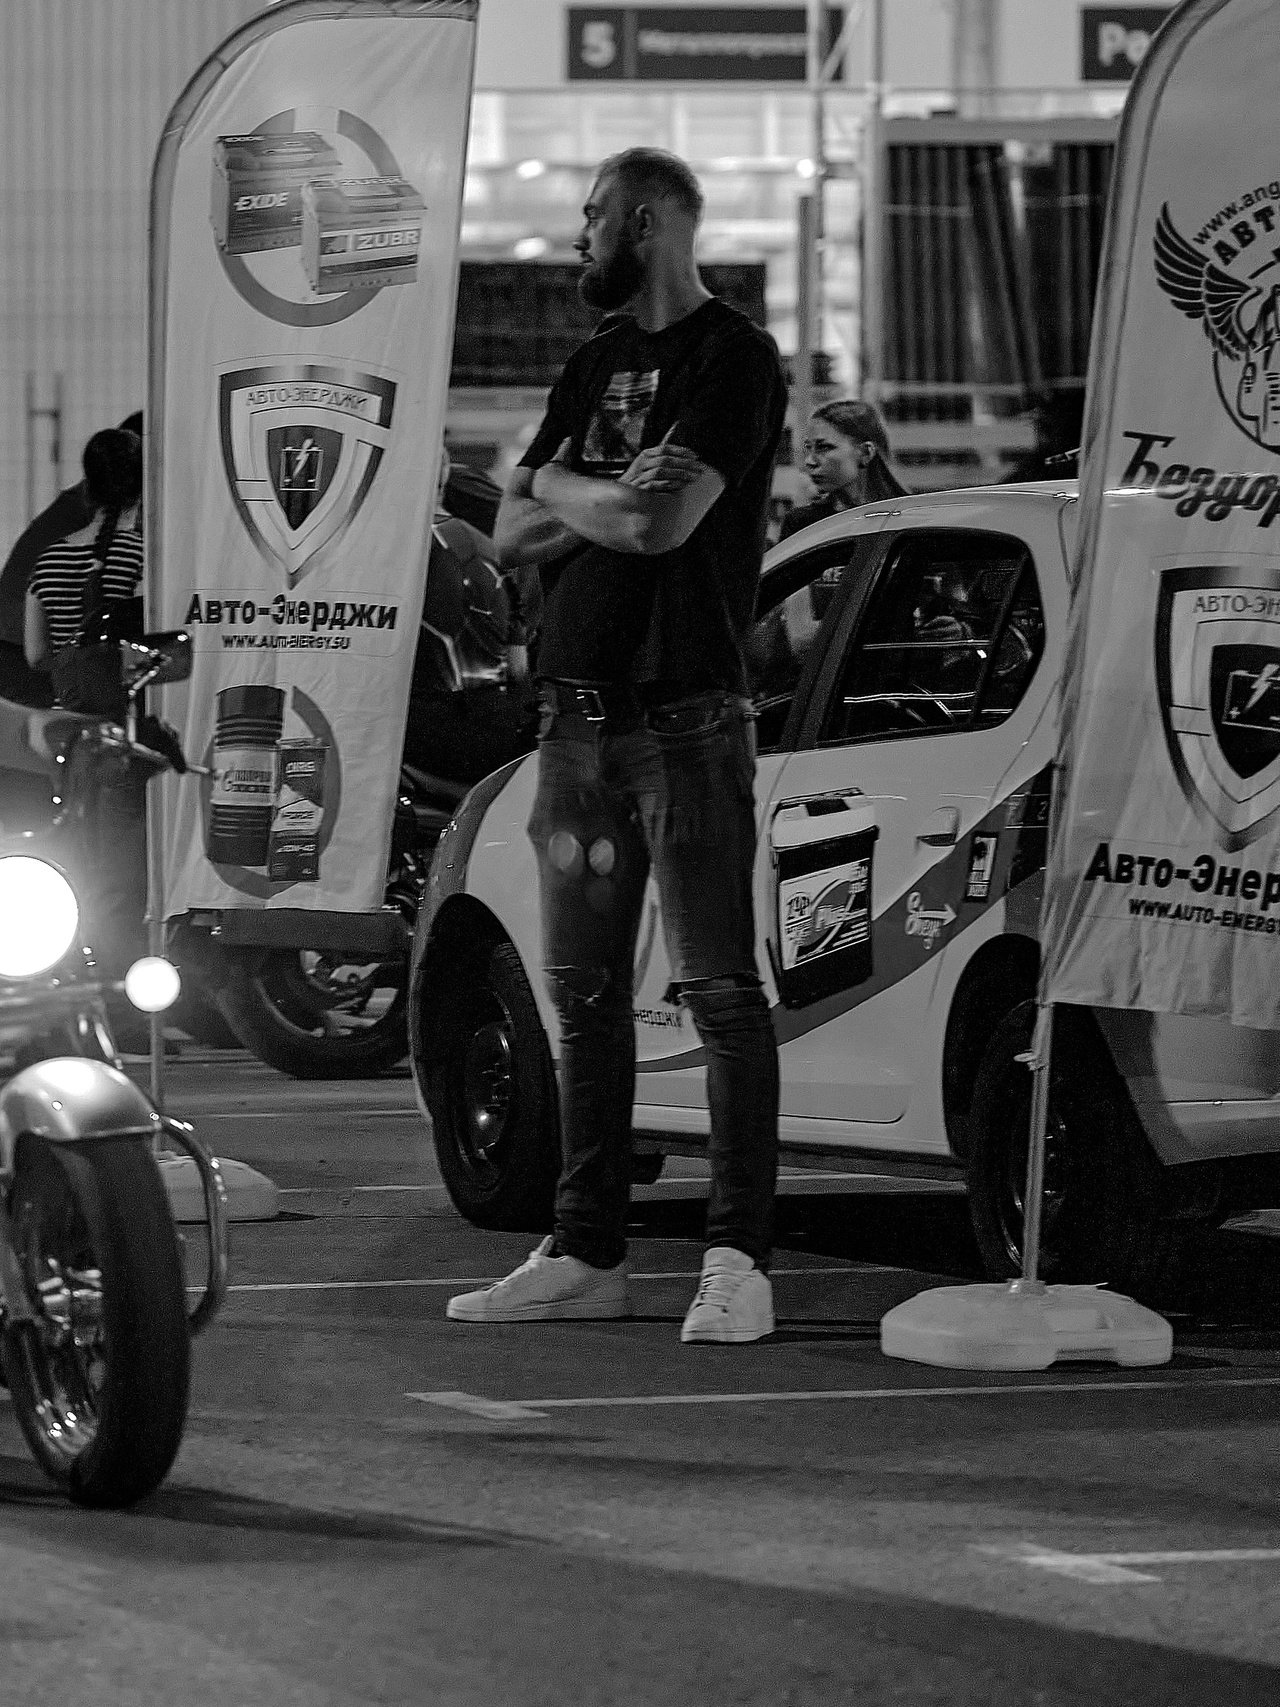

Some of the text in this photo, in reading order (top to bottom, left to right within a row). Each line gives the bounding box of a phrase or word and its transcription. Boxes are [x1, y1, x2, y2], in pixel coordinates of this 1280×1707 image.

[581, 21, 616, 68] 5
[356, 230, 418, 250] ZUBR
[184, 593, 398, 632] Авто-Энерджи
[1128, 898, 1280, 935] WWW.AUTO-ENERG
